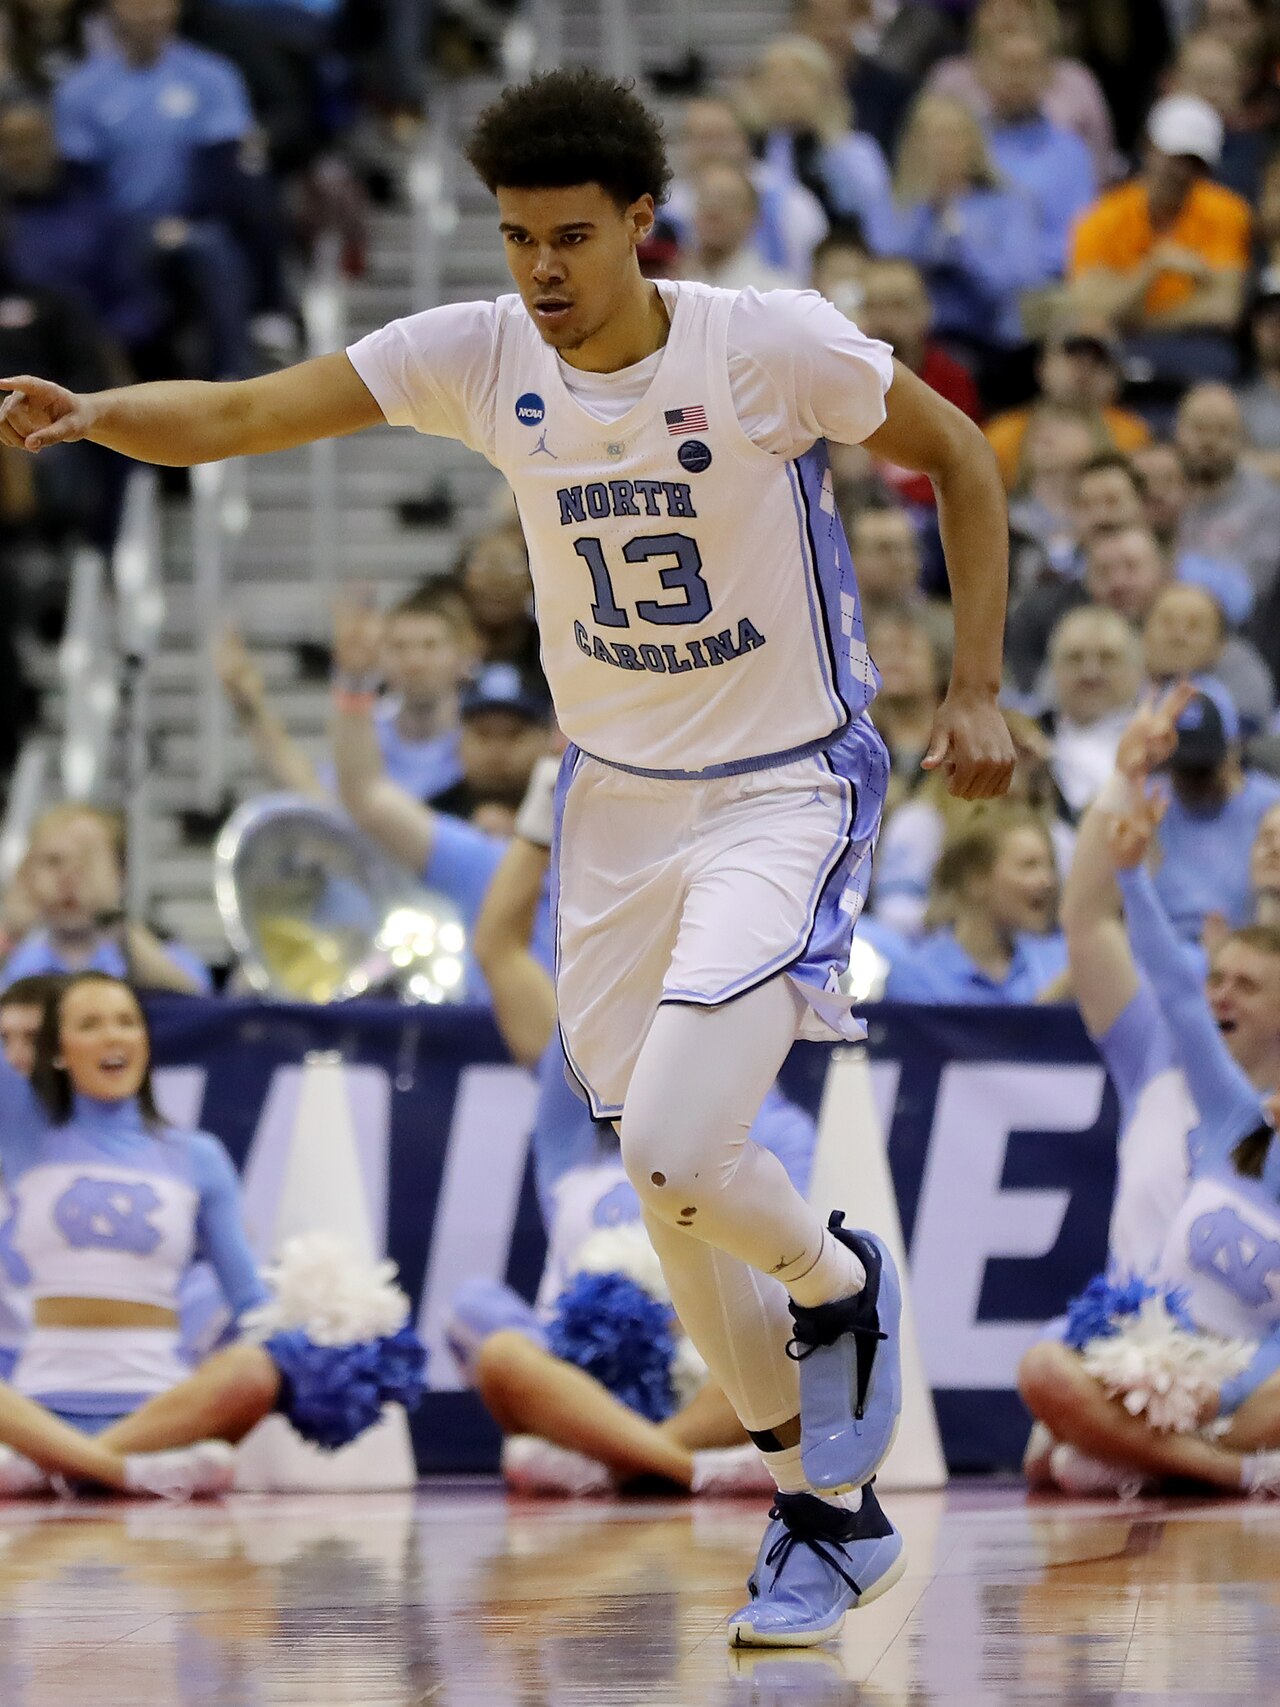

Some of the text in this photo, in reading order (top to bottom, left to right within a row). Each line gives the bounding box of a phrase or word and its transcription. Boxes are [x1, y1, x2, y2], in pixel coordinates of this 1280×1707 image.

[517, 407, 543, 419] NCAA
[557, 480, 696, 525] NORTH
[573, 533, 712, 628] 13
[574, 617, 765, 674] CAROLINA
